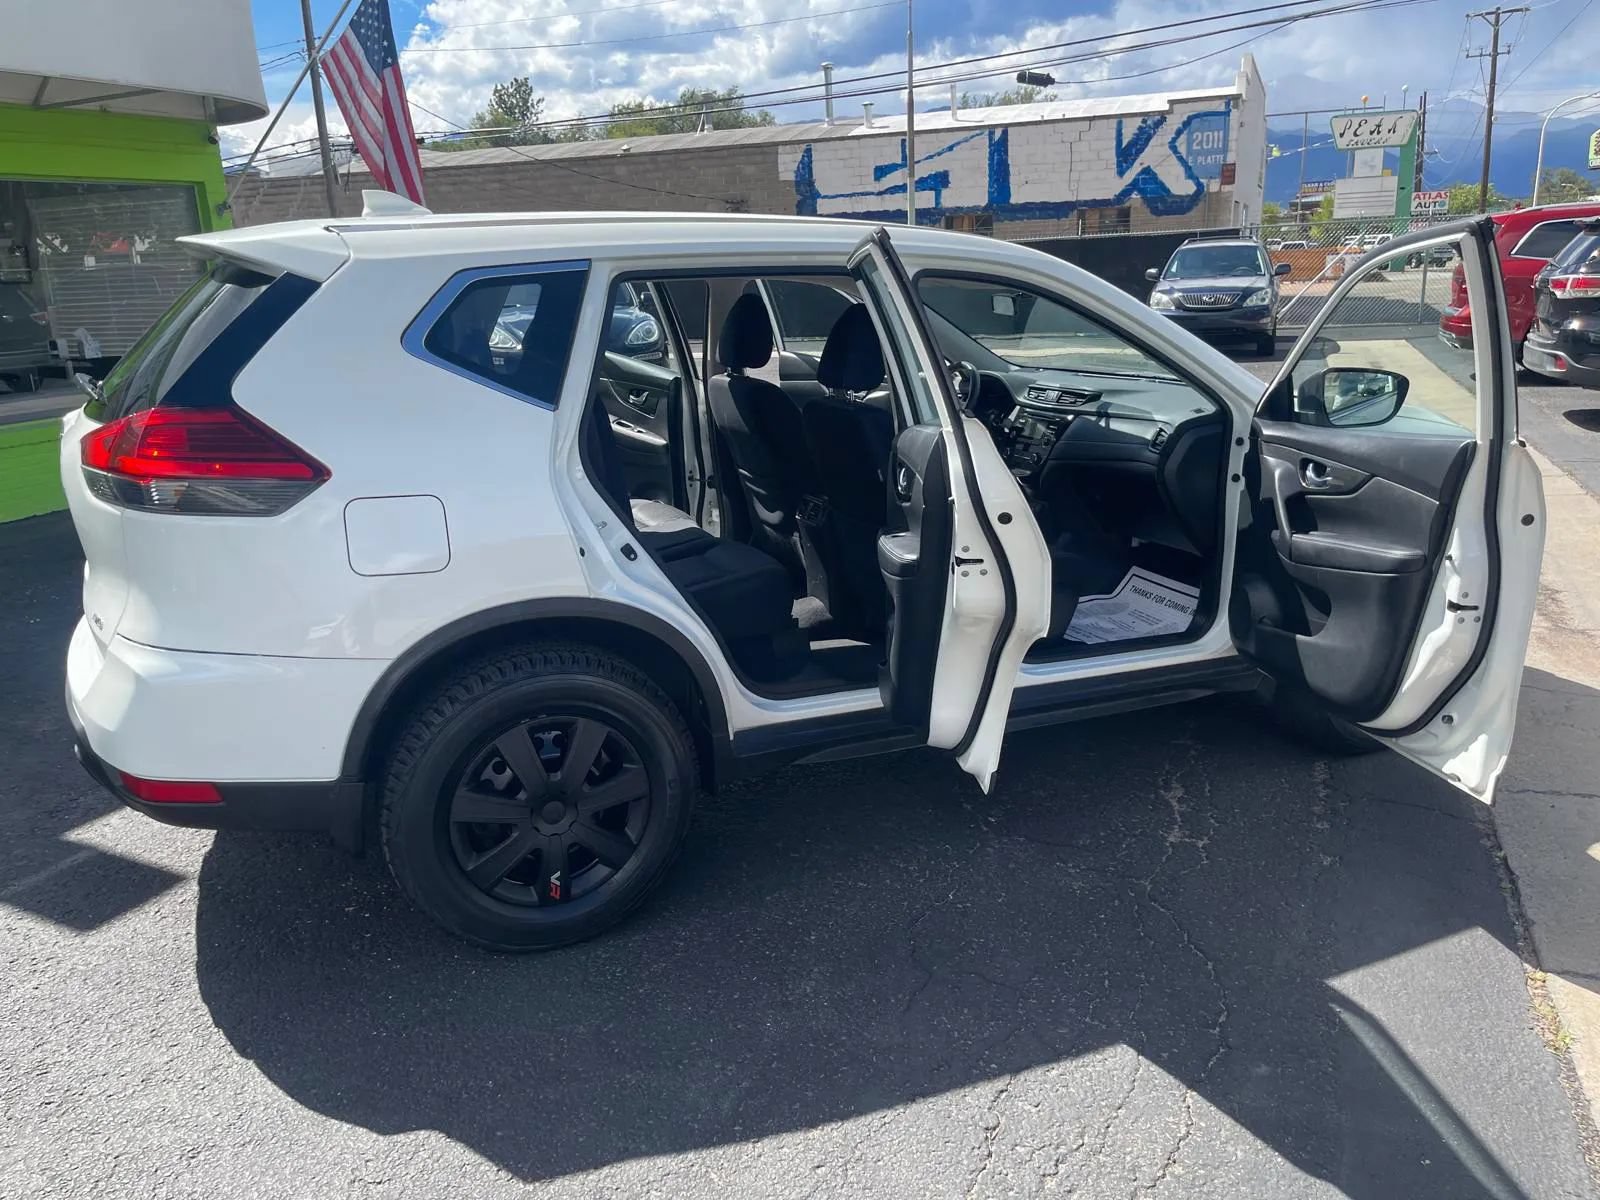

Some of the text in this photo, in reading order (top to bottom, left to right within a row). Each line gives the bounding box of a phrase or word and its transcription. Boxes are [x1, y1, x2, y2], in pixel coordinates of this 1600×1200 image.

[1192, 130, 1224, 150] 2011
[1197, 154, 1225, 165] PLATTE
[1413, 191, 1449, 201] ATLAS
[1414, 200, 1447, 209] AUTO
[1129, 585, 1154, 600] THANKS
[1151, 594, 1166, 605] FOR
[1164, 599, 1190, 614] COMING
